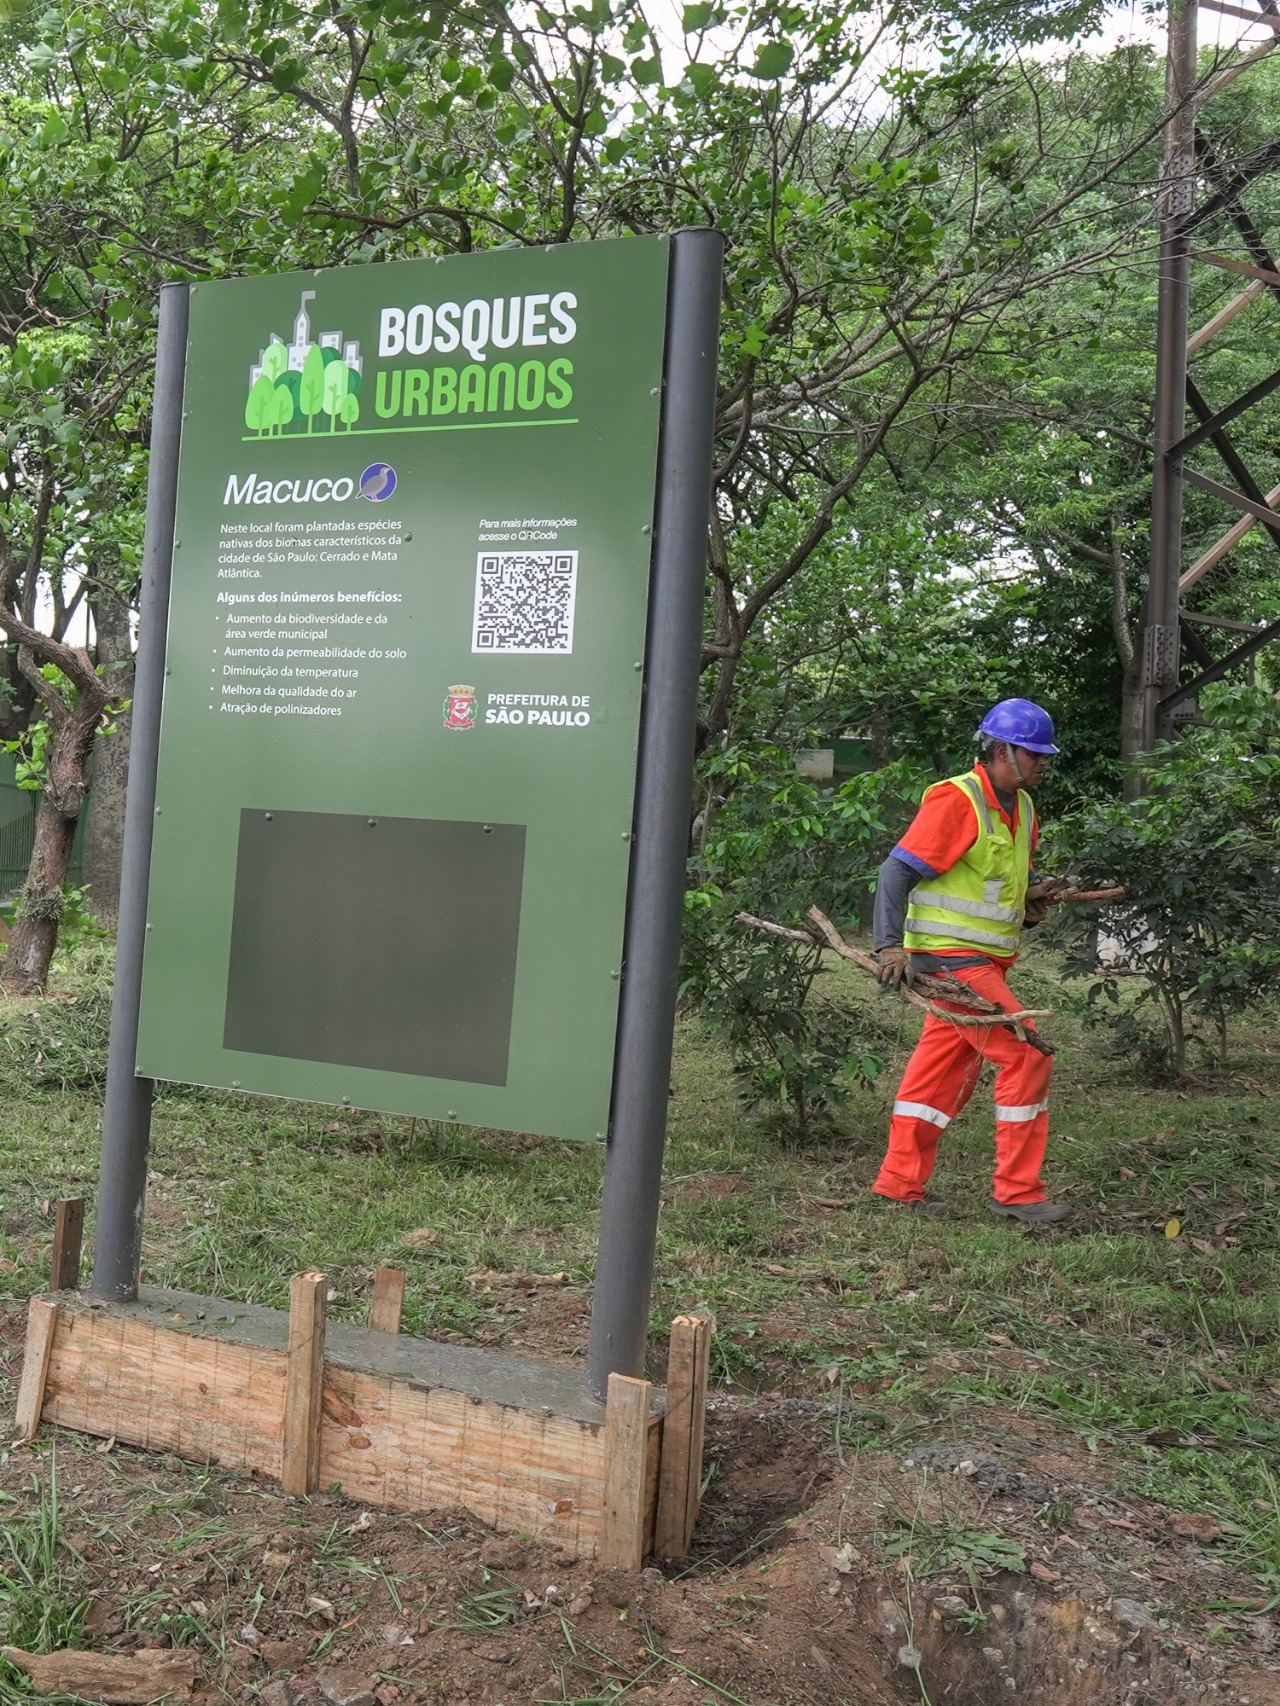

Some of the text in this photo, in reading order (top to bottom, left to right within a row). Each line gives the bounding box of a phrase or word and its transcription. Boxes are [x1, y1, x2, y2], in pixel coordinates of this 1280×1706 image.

[378, 292, 577, 361] BOSQUES
[375, 358, 573, 418] URBANOS
[223, 473, 353, 505] Macuco
[220, 519, 401, 534] Neste local foram plantadas espécies
[479, 518, 577, 528] Para mais informações
[219, 535, 401, 548] nativas dos biomas característicos da
[218, 553, 250, 563] cidade
[253, 552, 265, 563] de
[267, 552, 285, 562] São
[288, 552, 318, 562] Paulo:
[320, 551, 360, 561] Cerrado
[371, 551, 397, 560] Mata
[217, 568, 262, 578] Atlântica.
[217, 591, 401, 605] Alguns dos inúmeros benefícios:
[226, 614, 271, 624] Aumento
[274, 614, 286, 624] da
[289, 613, 363, 624] biodiversidade
[374, 614, 387, 624] da
[225, 629, 327, 640] área verde municipal
[224, 646, 406, 659] Aumento da permeabilidade do solo
[223, 665, 358, 678] Diminuição da temperatura
[222, 685, 357, 698] Melhora da qualidade do ar
[488, 694, 590, 707] PREFEITURA DE
[220, 702, 341, 716] Atração de polinizadores
[485, 706, 524, 724] SÃO
[528, 710, 590, 726] PAULO
